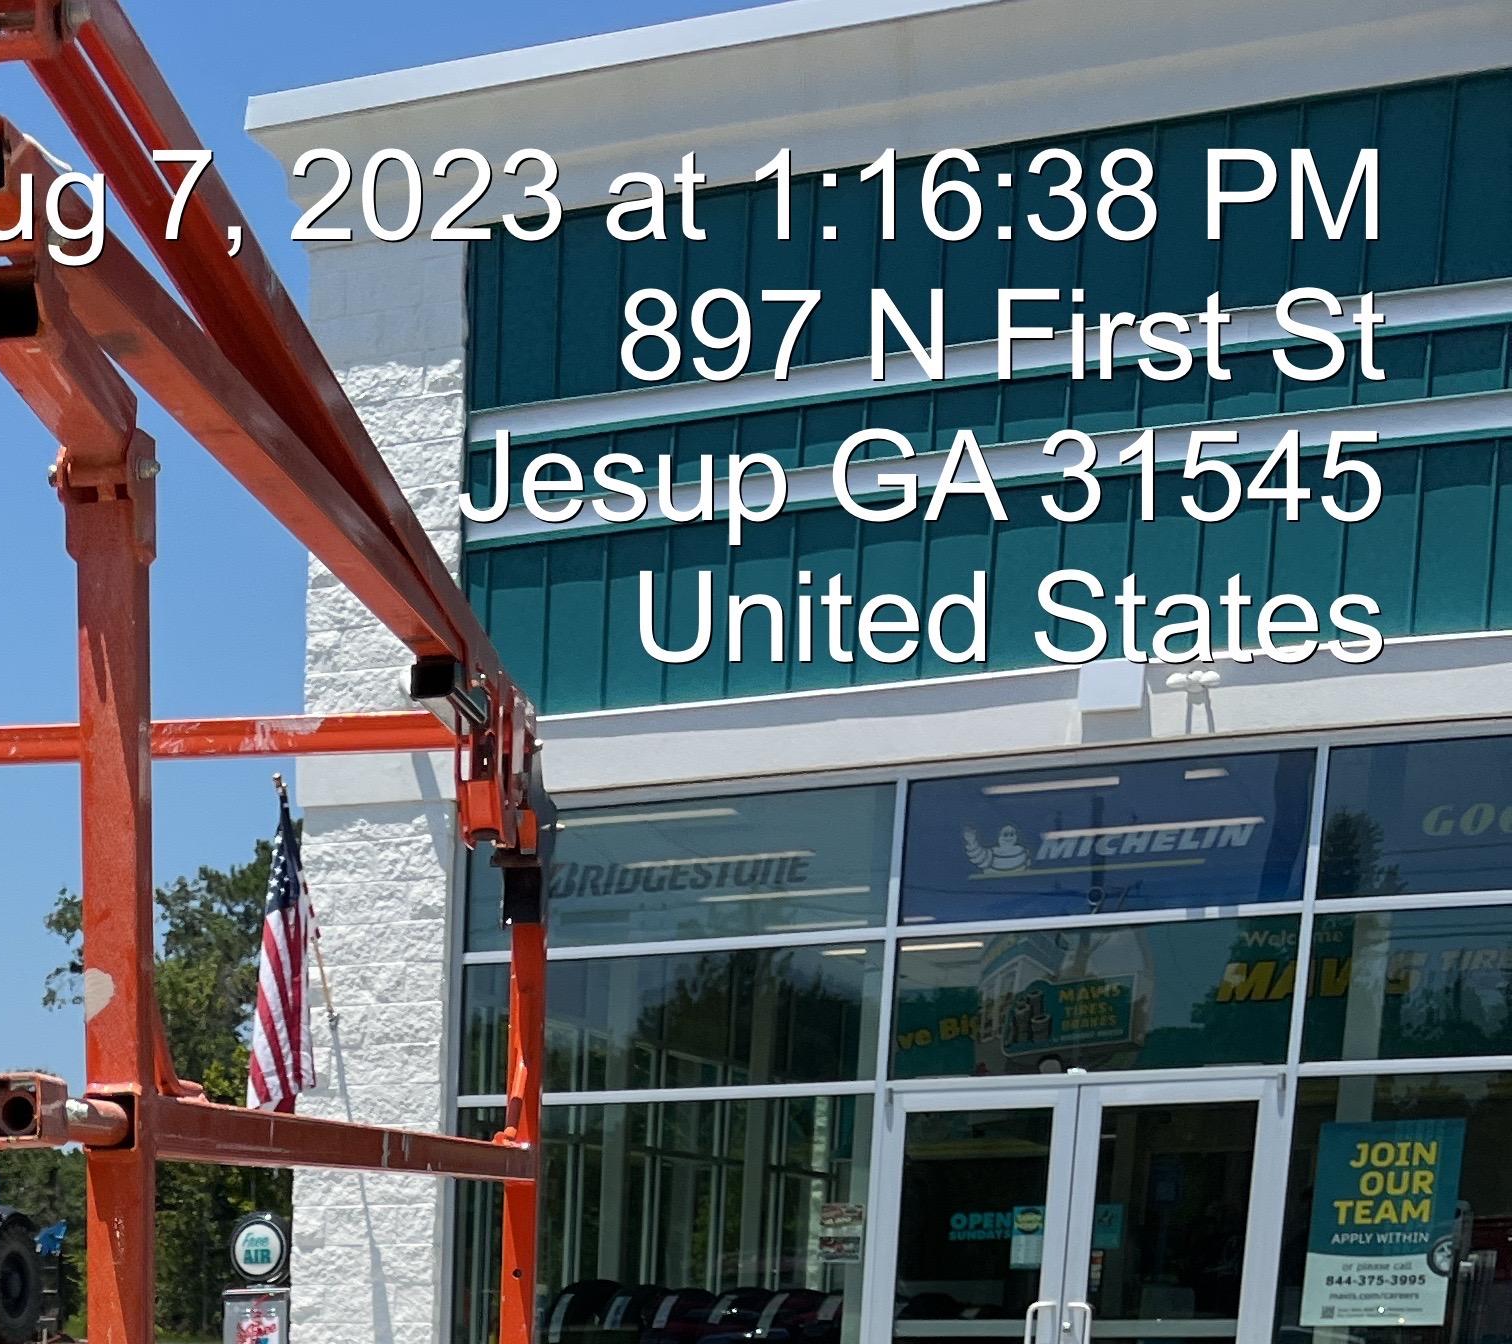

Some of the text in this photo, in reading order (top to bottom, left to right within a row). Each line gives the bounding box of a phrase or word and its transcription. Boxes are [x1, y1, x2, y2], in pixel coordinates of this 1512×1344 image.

[1035, 821, 1259, 861] MICHELIN
[549, 855, 810, 899] BRIDGESTONE
[1349, 1141, 1438, 1168] JOIN
[1359, 1170, 1435, 1197] OUR
[949, 1211, 1012, 1231] OPEN
[1333, 1199, 1432, 1225] TEAM
[1331, 1231, 1430, 1245] APPLY WITHIN
[243, 1248, 272, 1264] AIR
[1325, 1274, 1427, 1286] 844-375-3995
